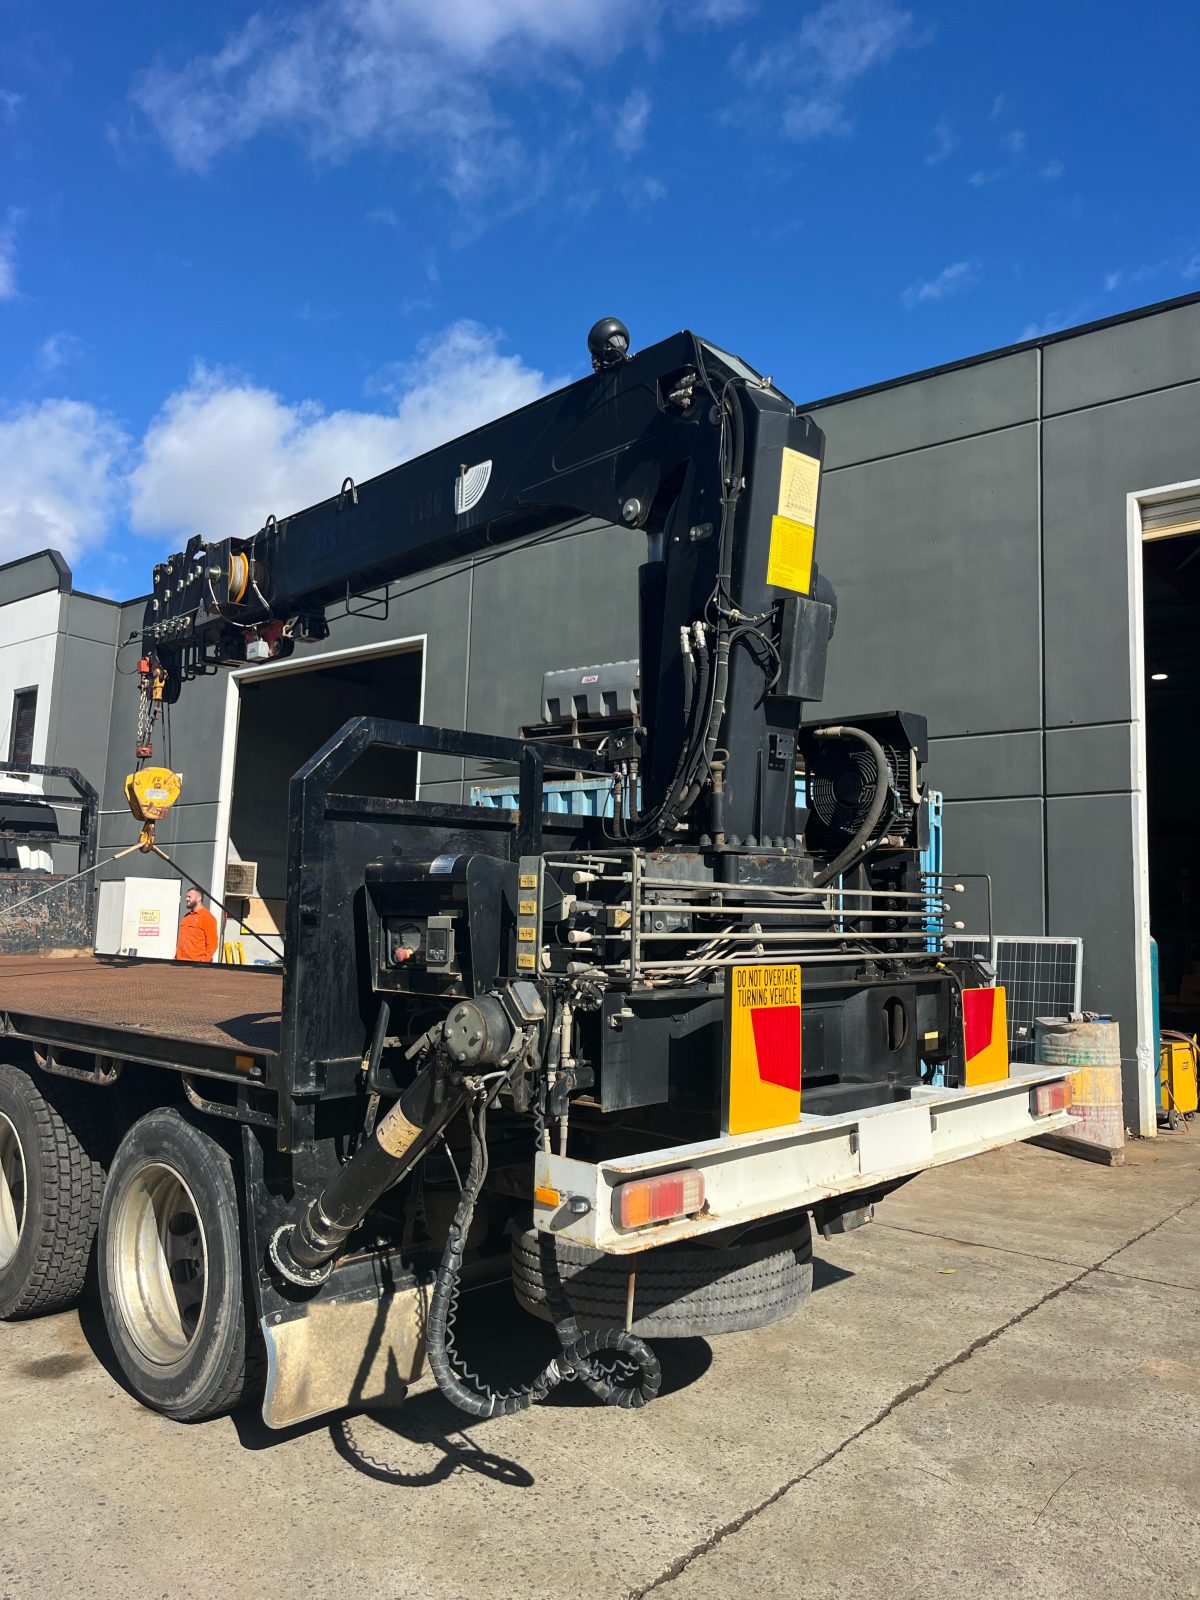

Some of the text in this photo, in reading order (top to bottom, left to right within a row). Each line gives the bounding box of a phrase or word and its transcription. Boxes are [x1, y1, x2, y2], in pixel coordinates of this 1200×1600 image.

[737, 968, 797, 987] DO NOT OVERTAKE
[738, 987, 797, 1007] TURNING VEHICLE
